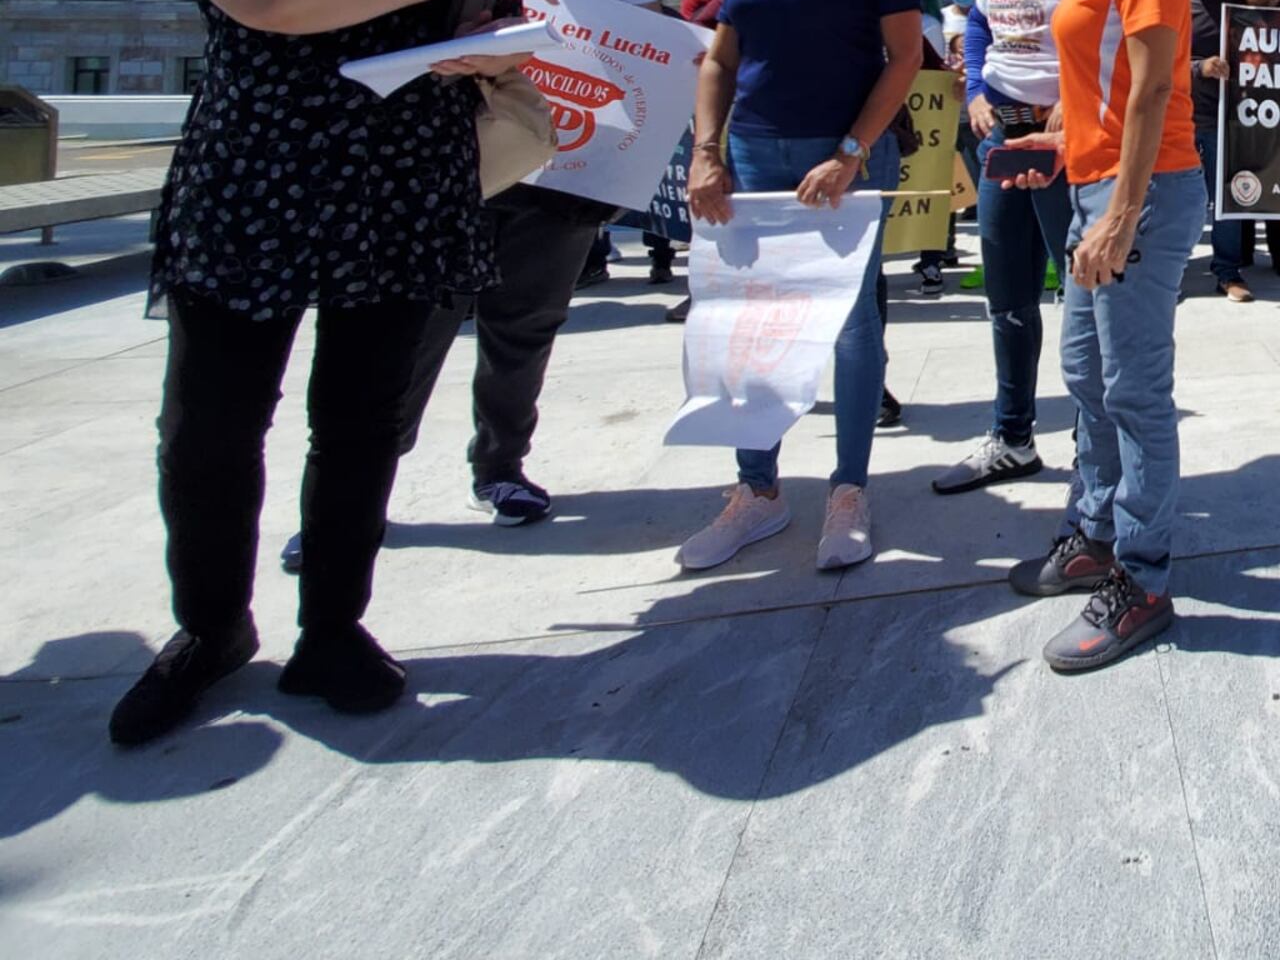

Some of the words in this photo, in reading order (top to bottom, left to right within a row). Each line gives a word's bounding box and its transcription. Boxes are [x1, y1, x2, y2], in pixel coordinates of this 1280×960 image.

[562, 23, 593, 42] en
[600, 29, 672, 65] Lucha
[582, 44, 624, 74] UNIDOS
[632, 86, 648, 128] PUERTO
[592, 84, 610, 103] 95
